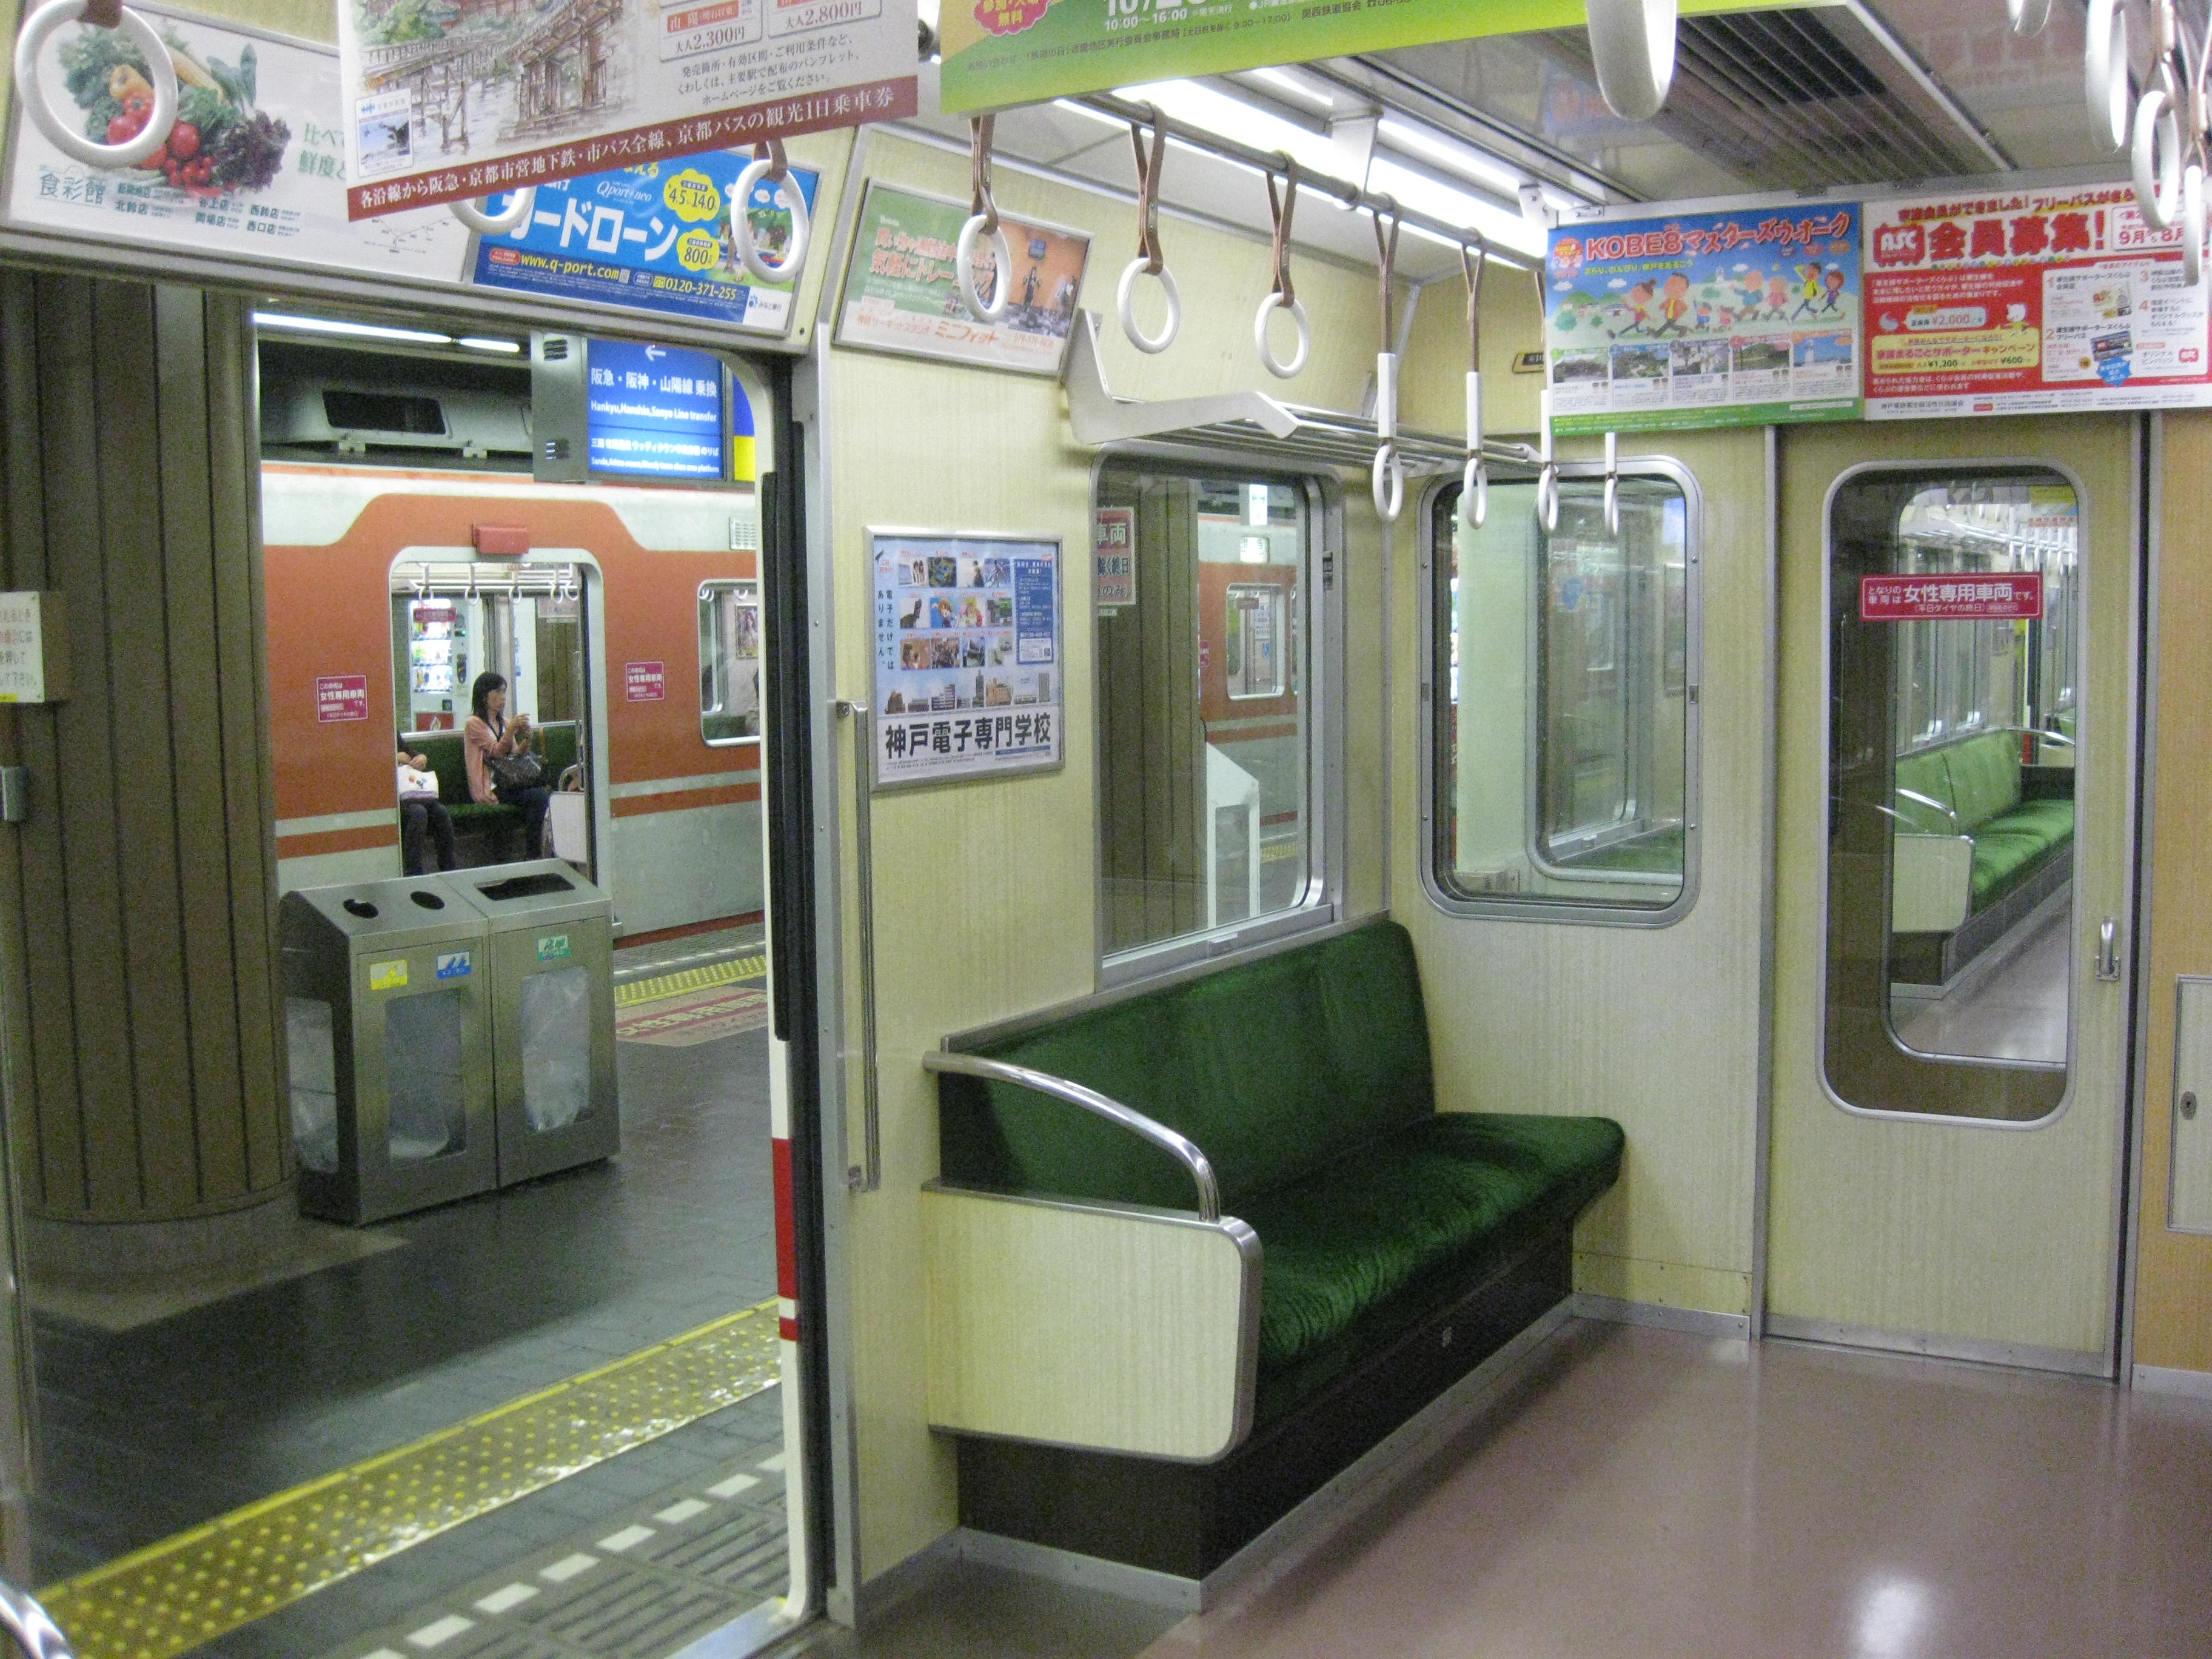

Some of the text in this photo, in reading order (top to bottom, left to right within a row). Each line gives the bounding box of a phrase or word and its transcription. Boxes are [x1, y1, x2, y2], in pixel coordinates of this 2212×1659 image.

[999, 10, 1022, 27] 無料
[39, 173, 106, 204] 食彩館
[247, 220, 277, 235] 西口店
[1927, 210, 2105, 263] 会員募集!
[1881, 230, 1917, 252] ASC
[521, 255, 619, 280] www.q-port.com
[666, 279, 737, 301] 0120-371-255
[2138, 300, 2148, 311] 4
[934, 321, 999, 343] ミニフィット
[2046, 329, 2055, 340] 2
[591, 367, 717, 397] 阪急・阪神・山陽線 乗換
[674, 408, 689, 420] Line
[689, 411, 717, 422] transfer
[1868, 586, 1902, 595] となりの
[1904, 583, 2013, 603] 女性専用車両
[885, 712, 1051, 760] 神戸電子専門学校
